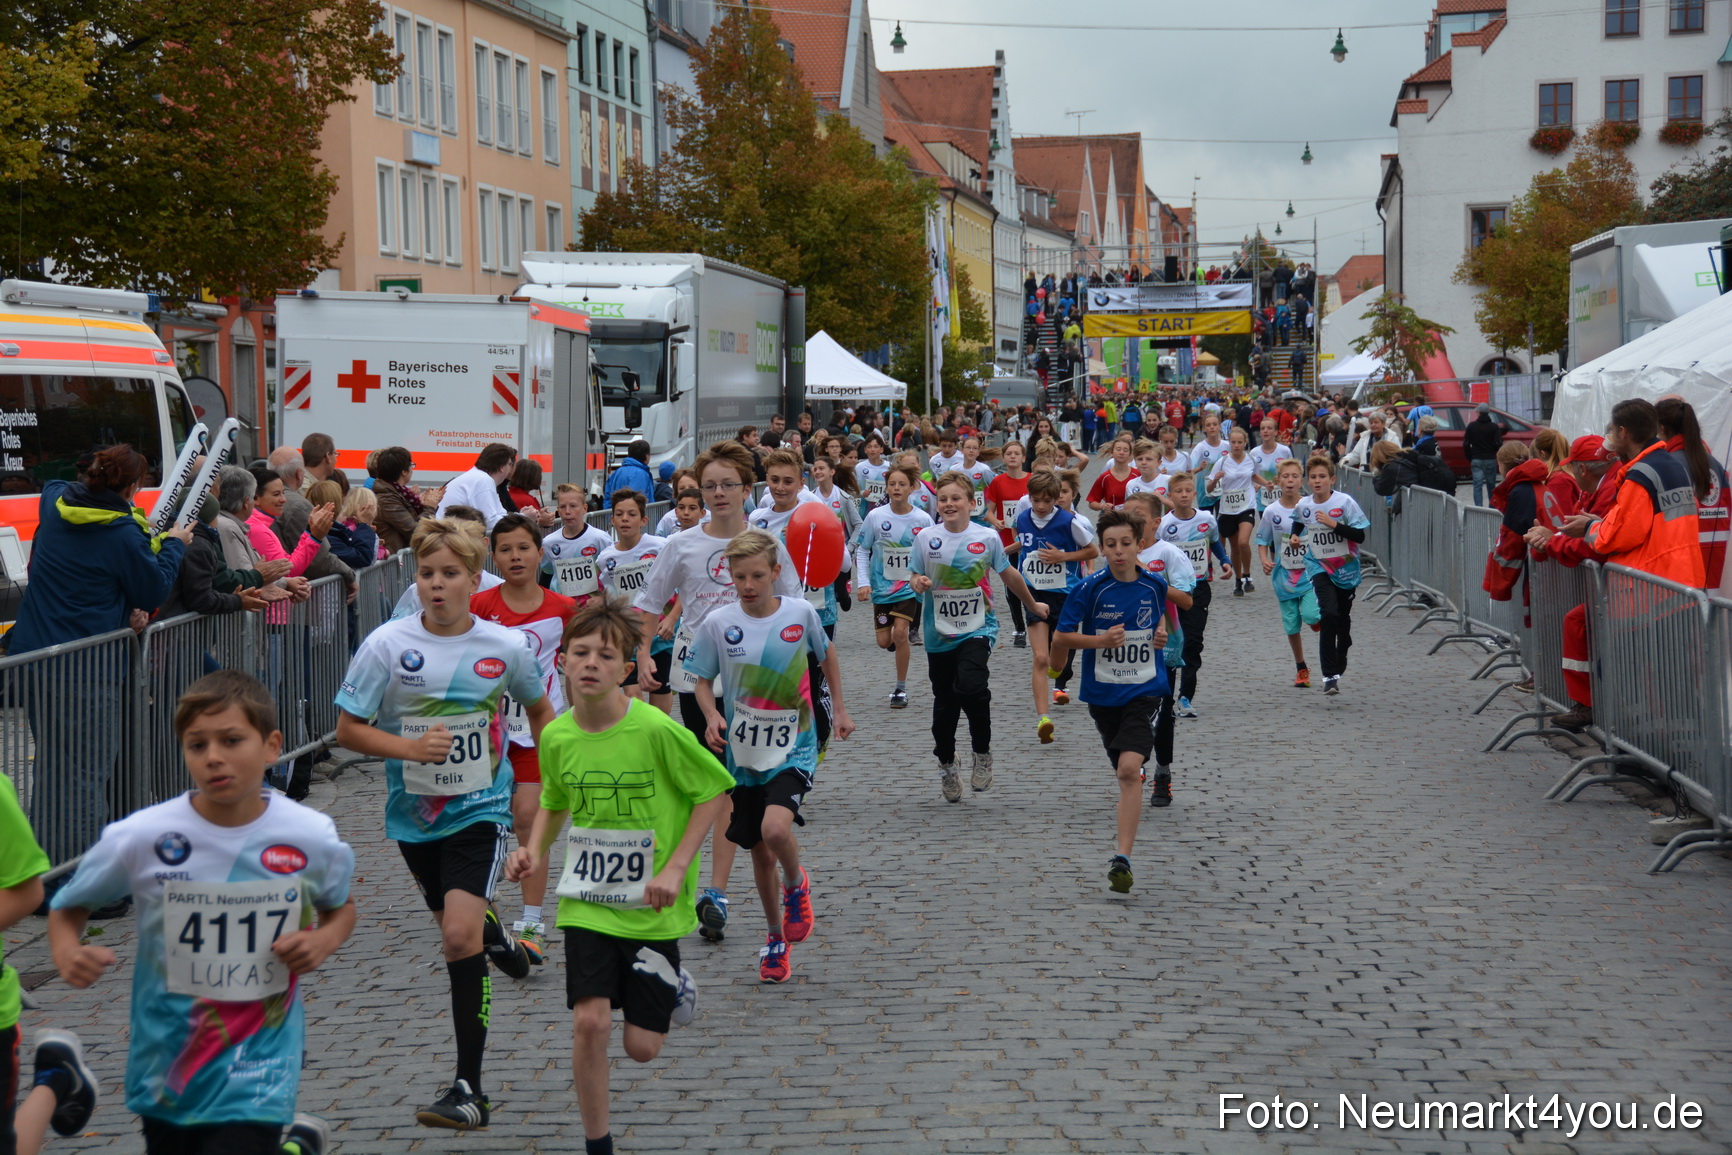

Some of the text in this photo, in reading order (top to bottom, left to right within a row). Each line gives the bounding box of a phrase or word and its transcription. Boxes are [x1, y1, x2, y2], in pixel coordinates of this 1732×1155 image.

[1137, 317, 1195, 332] START
[487, 348, 515, 356] 44/54/1
[756, 324, 778, 370] BOCK
[388, 360, 469, 375] Bayerisches
[388, 376, 426, 389] Rotes
[810, 384, 863, 397] Laufsport
[387, 393, 426, 405] Kreuz
[0, 408, 38, 431] Bayerisches
[1, 430, 22, 449] Rotes
[428, 429, 513, 440] Katastrophenschutz
[436, 439, 491, 450] Freistaat Bay
[4, 452, 25, 471] Kreuz
[1225, 493, 1245, 504] 4034
[1018, 532, 1034, 547] 13
[1284, 544, 1308, 557] 403
[887, 555, 910, 568] 411
[1027, 559, 1062, 575] 4025
[560, 565, 593, 582] 4106
[620, 571, 645, 591] 400
[1034, 577, 1054, 585] Fabian
[695, 591, 719, 599] LAUFEN
[939, 599, 979, 618] 4027
[954, 620, 967, 628] Tim
[1101, 643, 1150, 664] 4006
[400, 674, 425, 683] PARTL
[1111, 668, 1139, 677] Yannik
[735, 706, 787, 723] PARTL Neumarkt
[446, 721, 475, 731] umarkt
[734, 720, 791, 748] 4113
[435, 772, 464, 785] Felix
[569, 835, 637, 847] PARTL Neumarkt
[573, 850, 644, 883] 4029
[168, 892, 279, 905] PARTL Neumarkt
[580, 890, 627, 904] Vinzenz
[178, 908, 290, 954] 4117
[190, 961, 274, 988] LUKAS
